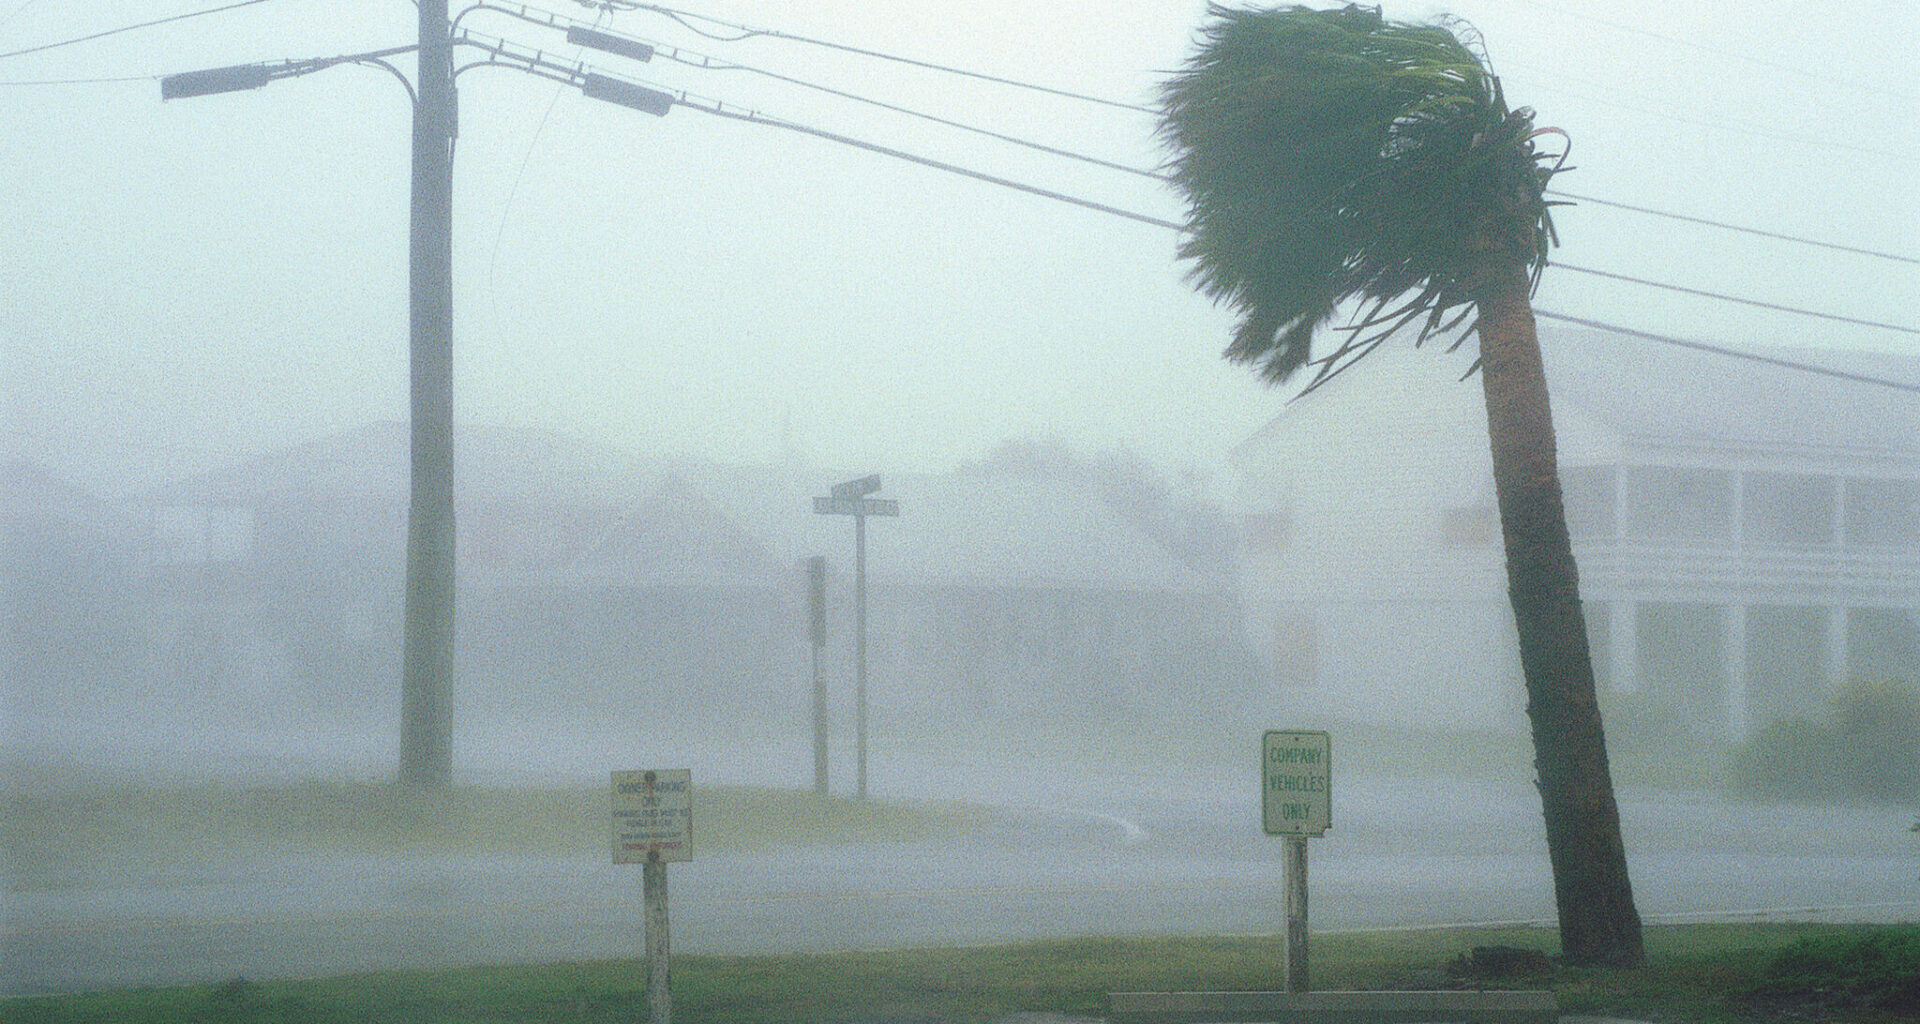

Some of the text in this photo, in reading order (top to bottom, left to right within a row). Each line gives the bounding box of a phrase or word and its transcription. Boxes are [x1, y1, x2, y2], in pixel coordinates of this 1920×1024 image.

[1270, 747, 1322, 764] COMPANY
[1270, 775, 1325, 793] VEHICLES
[1282, 802, 1311, 821] ONLY
